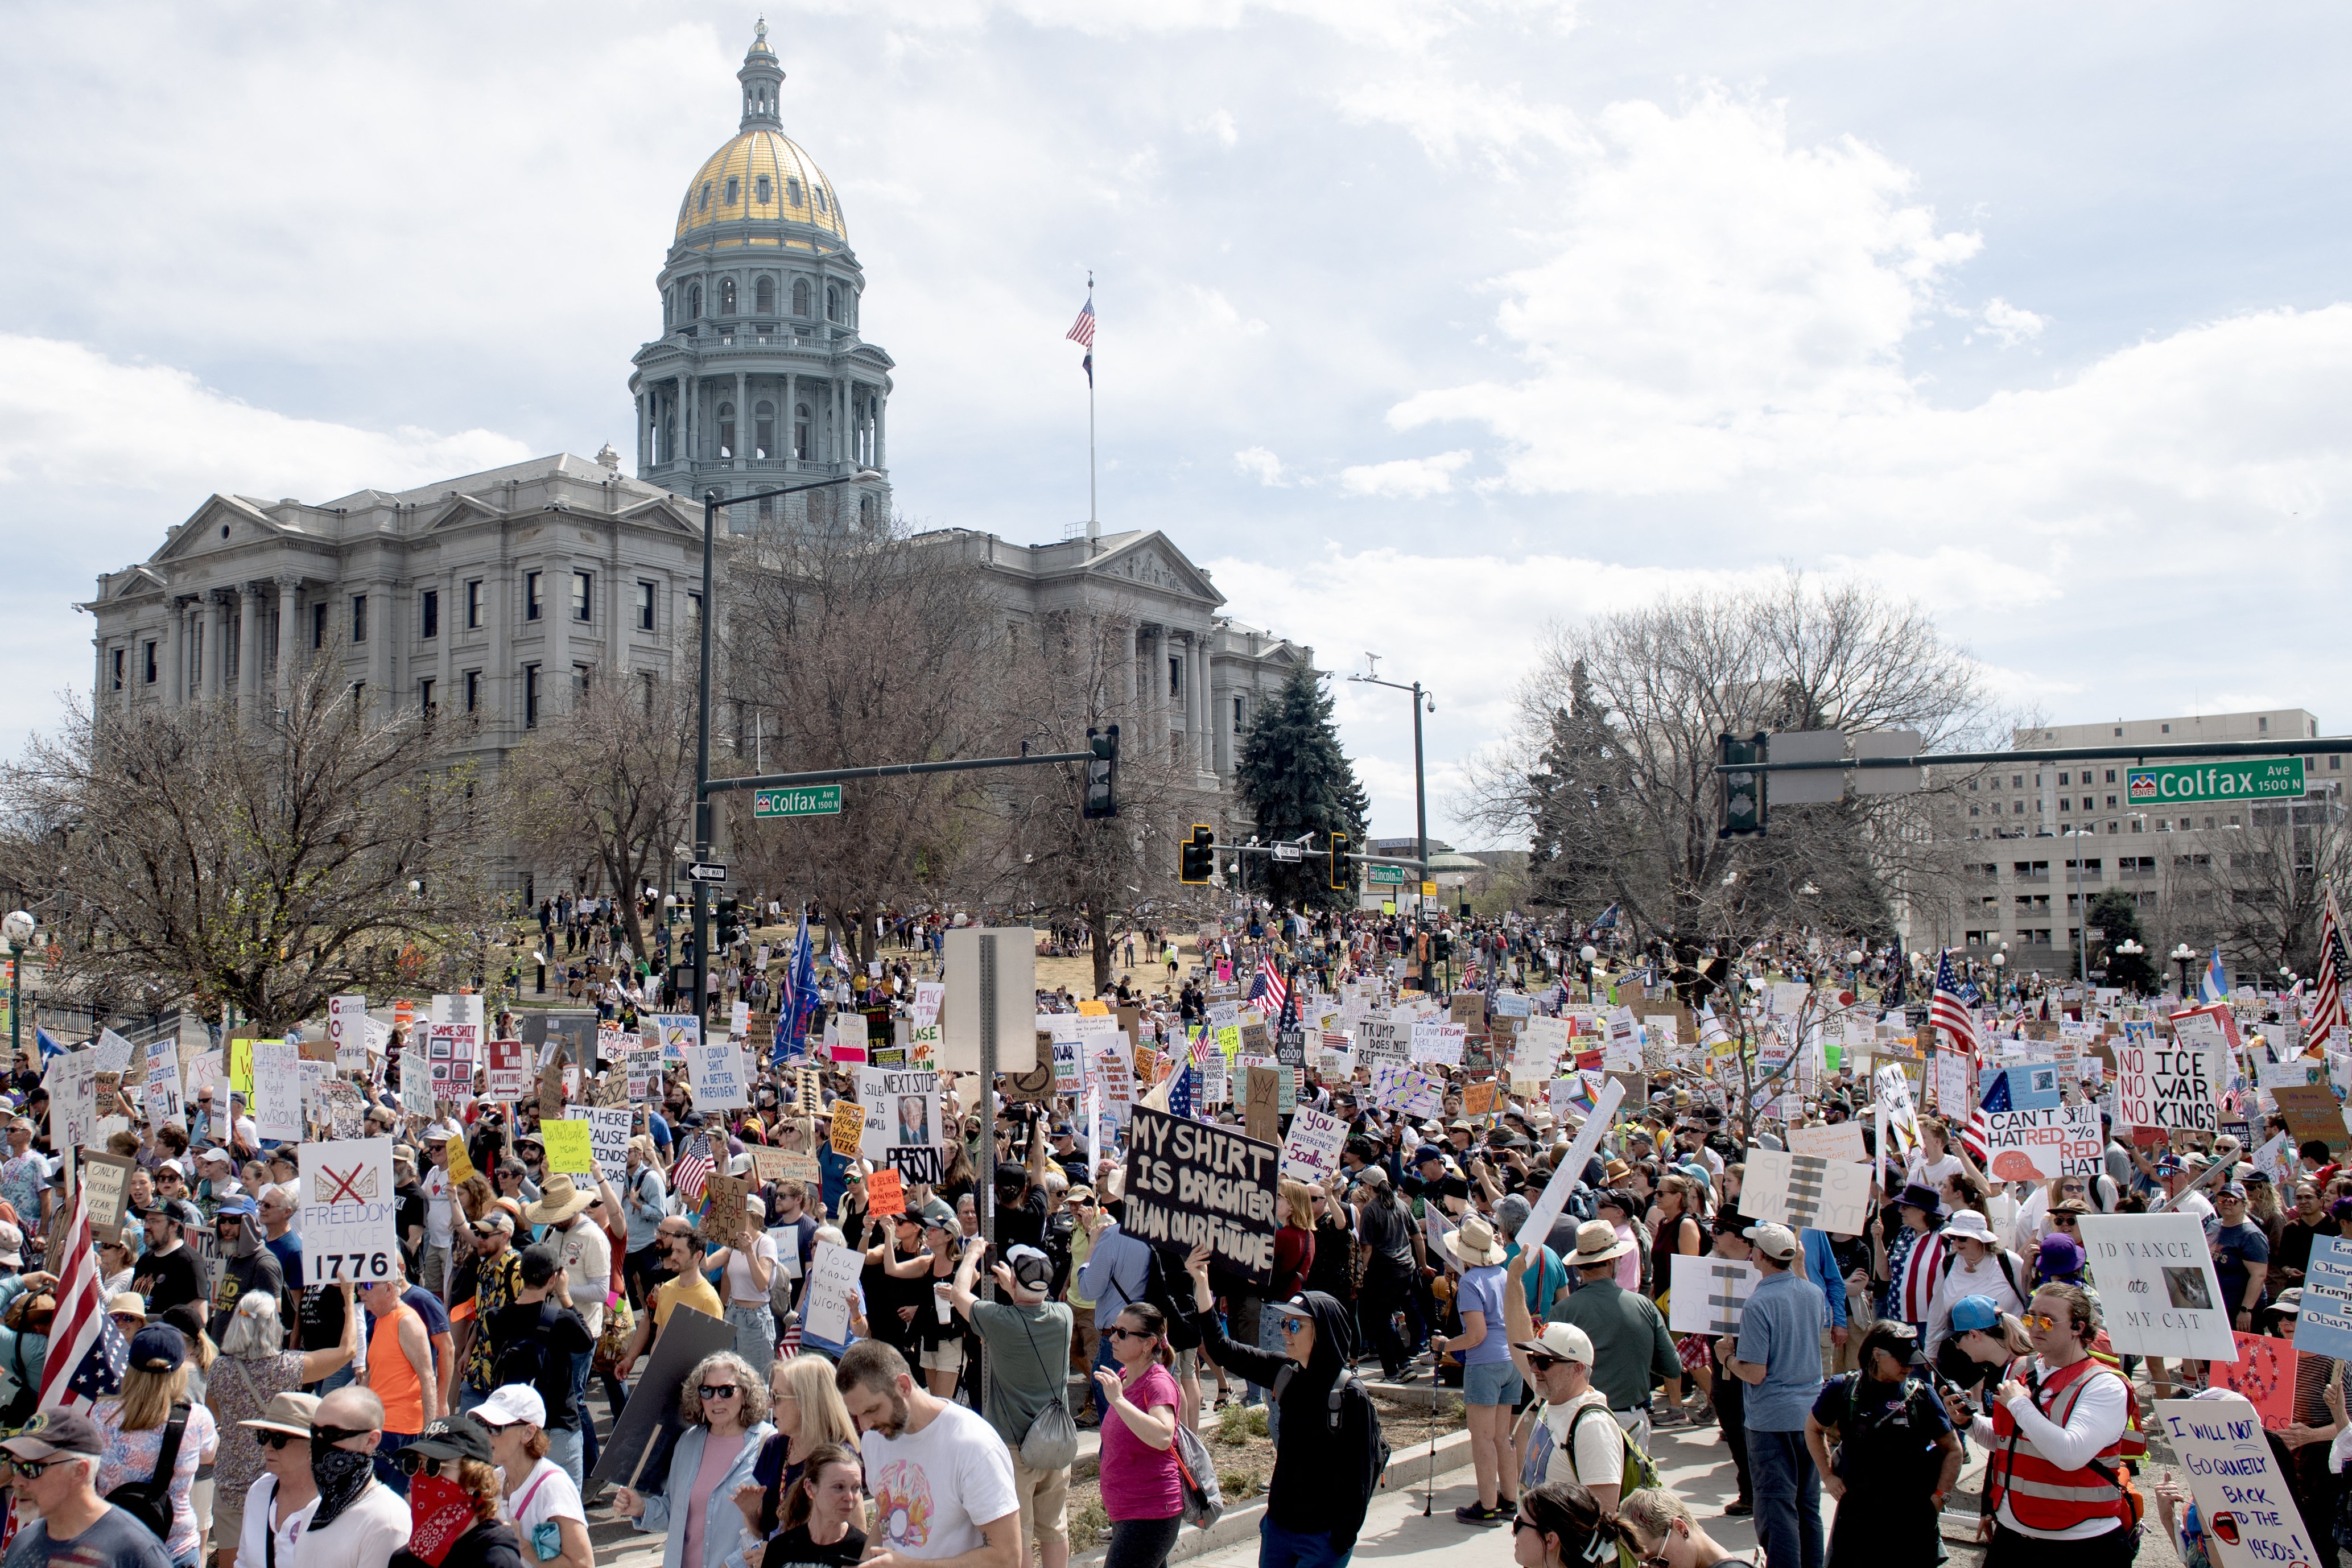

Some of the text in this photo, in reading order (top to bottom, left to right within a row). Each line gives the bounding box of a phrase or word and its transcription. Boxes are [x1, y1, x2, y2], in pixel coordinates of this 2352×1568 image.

[2268, 766, 2290, 776] Ave
[2160, 769, 2254, 797] Colfax
[2258, 779, 2301, 791] 1500 N
[772, 793, 816, 812] Colfax
[1376, 869, 1396, 881] Lincoln
[659, 1017, 697, 1028] NO KINGS
[431, 1025, 476, 1038] SAME SHIT
[1219, 1027, 1236, 1037] VOTE
[1244, 1027, 1264, 1037] RESIST
[1282, 1033, 1302, 1043] VOTE
[1359, 1022, 1395, 1039] TRUMP
[1416, 1027, 1465, 1037] DUMP TRUMP
[1219, 1036, 1237, 1045] THEM
[1370, 1039, 1407, 1051] DOES NOT
[1413, 1038, 1463, 1049] ABOLISH ICE
[146, 1041, 171, 1058] LIBERTY
[501, 1045, 510, 1055] NO
[628, 1051, 660, 1063] JUSTICE
[700, 1047, 729, 1059] I COULD
[1280, 1049, 1301, 1059] GOOD
[148, 1057, 160, 1071] AND
[504, 1057, 521, 1067] KING
[708, 1060, 723, 1071] SHIT
[2120, 1049, 2205, 1077] NO ICE
[149, 1066, 175, 1082] JUSTICE
[492, 1073, 521, 1084] ANYTIME
[710, 1073, 734, 1084] BETTER
[151, 1082, 163, 1096] FOR
[265, 1080, 284, 1095] Right
[406, 1071, 430, 1096] HAS NO
[431, 1083, 472, 1094] DIFFERENT
[884, 1072, 938, 1093] NEXT STOP
[2121, 1075, 2207, 1102] NO WAR
[438, 1092, 456, 1101] HAT
[700, 1086, 737, 1098] PRESIDENT
[1464, 1087, 1484, 1096] TRUMP
[270, 1098, 284, 1107] And
[404, 1090, 432, 1115] KINGS!
[837, 1105, 849, 1114] No
[876, 1102, 885, 1114] IS
[259, 1109, 300, 1128] WRONG
[599, 1112, 629, 1127] HERE
[1990, 1107, 2099, 1130] CAN'T SPELL
[2122, 1100, 2216, 1132] NO KINGS
[833, 1138, 856, 1152] 1776
[1291, 1130, 1332, 1152] DIFFERENCE
[1988, 1128, 2065, 1148] HATRED
[1132, 1116, 1274, 1181] MY SHIRT
[1827, 1150, 1847, 1160] HOPE
[2060, 1140, 2101, 1159] RED
[92, 1165, 118, 1178] ONLY
[886, 1147, 944, 1185] PRISON
[2061, 1157, 2103, 1176] HAT
[86, 1180, 122, 1195] DICTATORS
[732, 1179, 738, 1194] A
[1137, 1155, 1274, 1228] IS BRIGHTER
[89, 1199, 110, 1210] FEAR
[304, 1202, 394, 1227] FREEDOM
[308, 1227, 382, 1249] SINCE
[1125, 1194, 1274, 1272] THAN OUR FUTURE
[2097, 1243, 2193, 1259] JD VANCE
[315, 1252, 389, 1281] 1776
[826, 1248, 855, 1270] You
[813, 1276, 846, 1298] this is
[2127, 1278, 2149, 1294] ate
[2126, 1311, 2201, 1330] MY CAT
[2168, 1417, 2254, 1441] I WILL NOT
[2186, 1454, 2266, 1477] GO QUIETLY
[2222, 1485, 2275, 1506] BACK
[2231, 1511, 2283, 1526] TO THE
